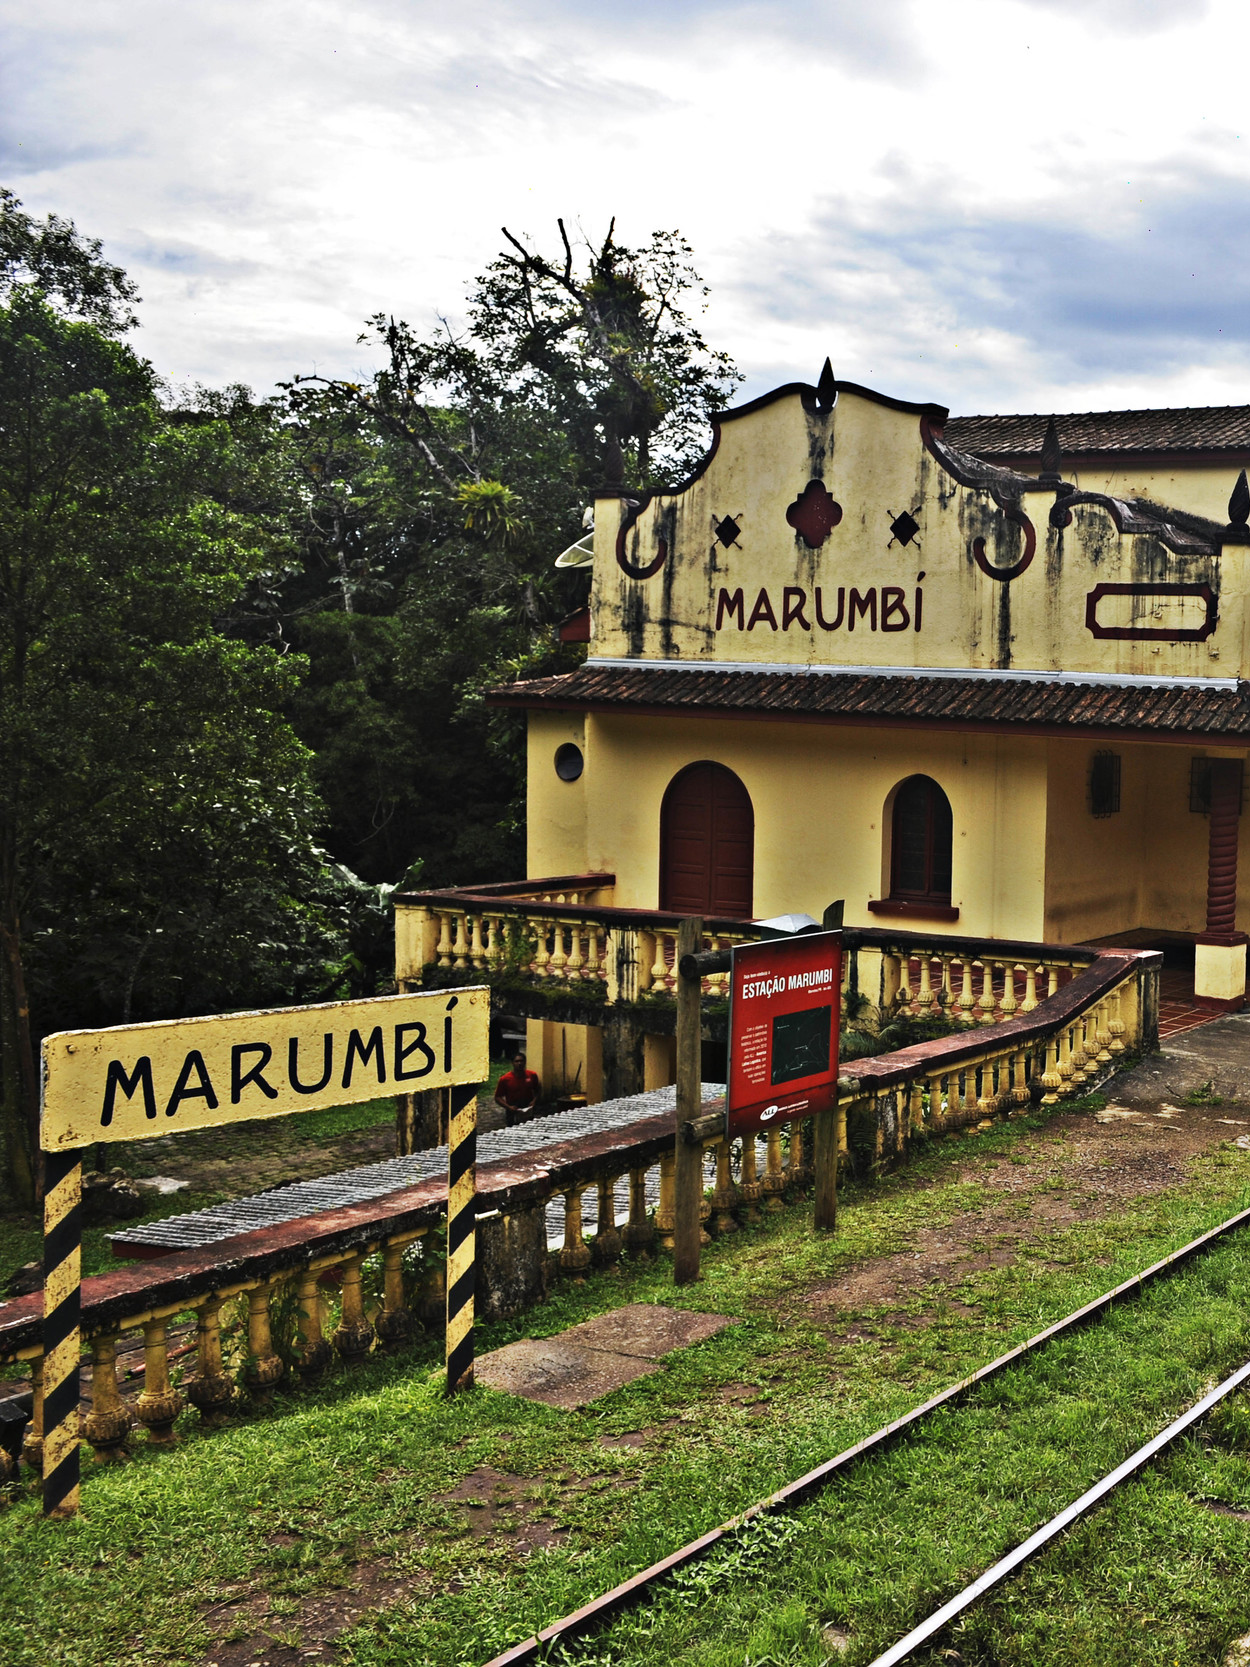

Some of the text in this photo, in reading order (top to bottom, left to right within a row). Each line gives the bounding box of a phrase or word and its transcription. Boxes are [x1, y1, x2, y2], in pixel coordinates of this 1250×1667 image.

[715, 571, 926, 632] MARUMBÍ
[742, 975, 786, 1000] ESTAÇÃO
[788, 968, 833, 990] MARUMBI
[100, 996, 459, 1127] MARUMBÍ
